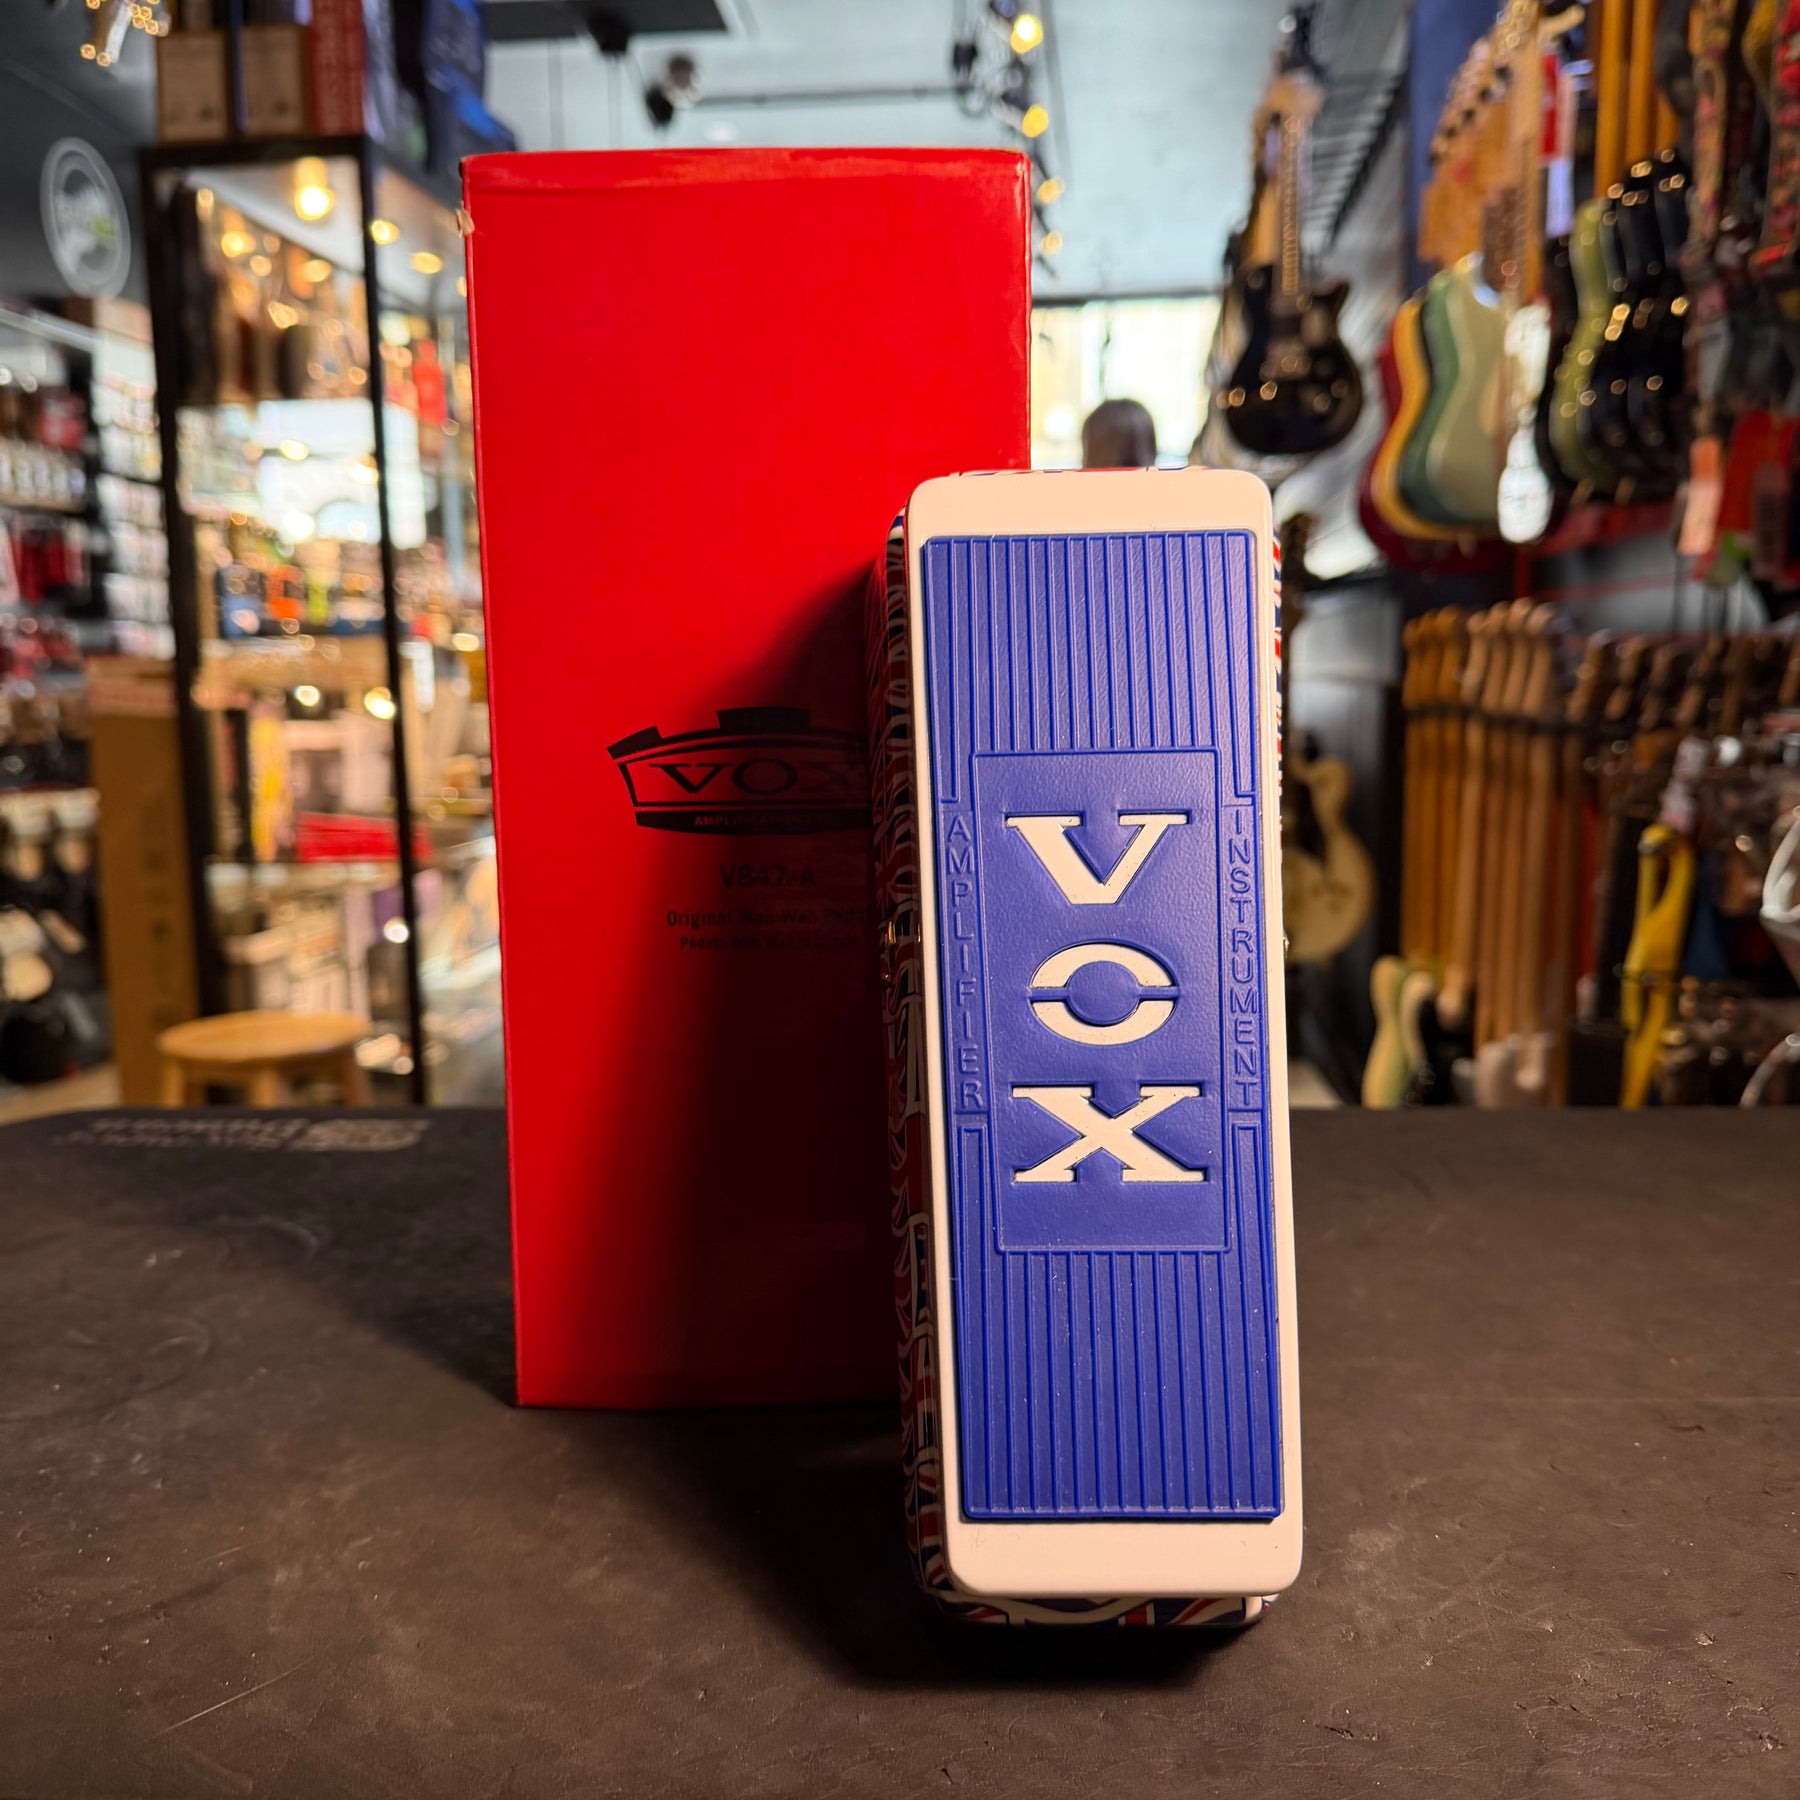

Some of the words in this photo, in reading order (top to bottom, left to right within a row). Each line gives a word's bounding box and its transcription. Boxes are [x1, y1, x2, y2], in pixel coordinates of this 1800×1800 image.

[648, 758, 869, 796] VOX
[666, 909, 731, 930] Original
[947, 812, 986, 1110] AMPLIFIER
[1228, 808, 1260, 1107] INSTRUMENT
